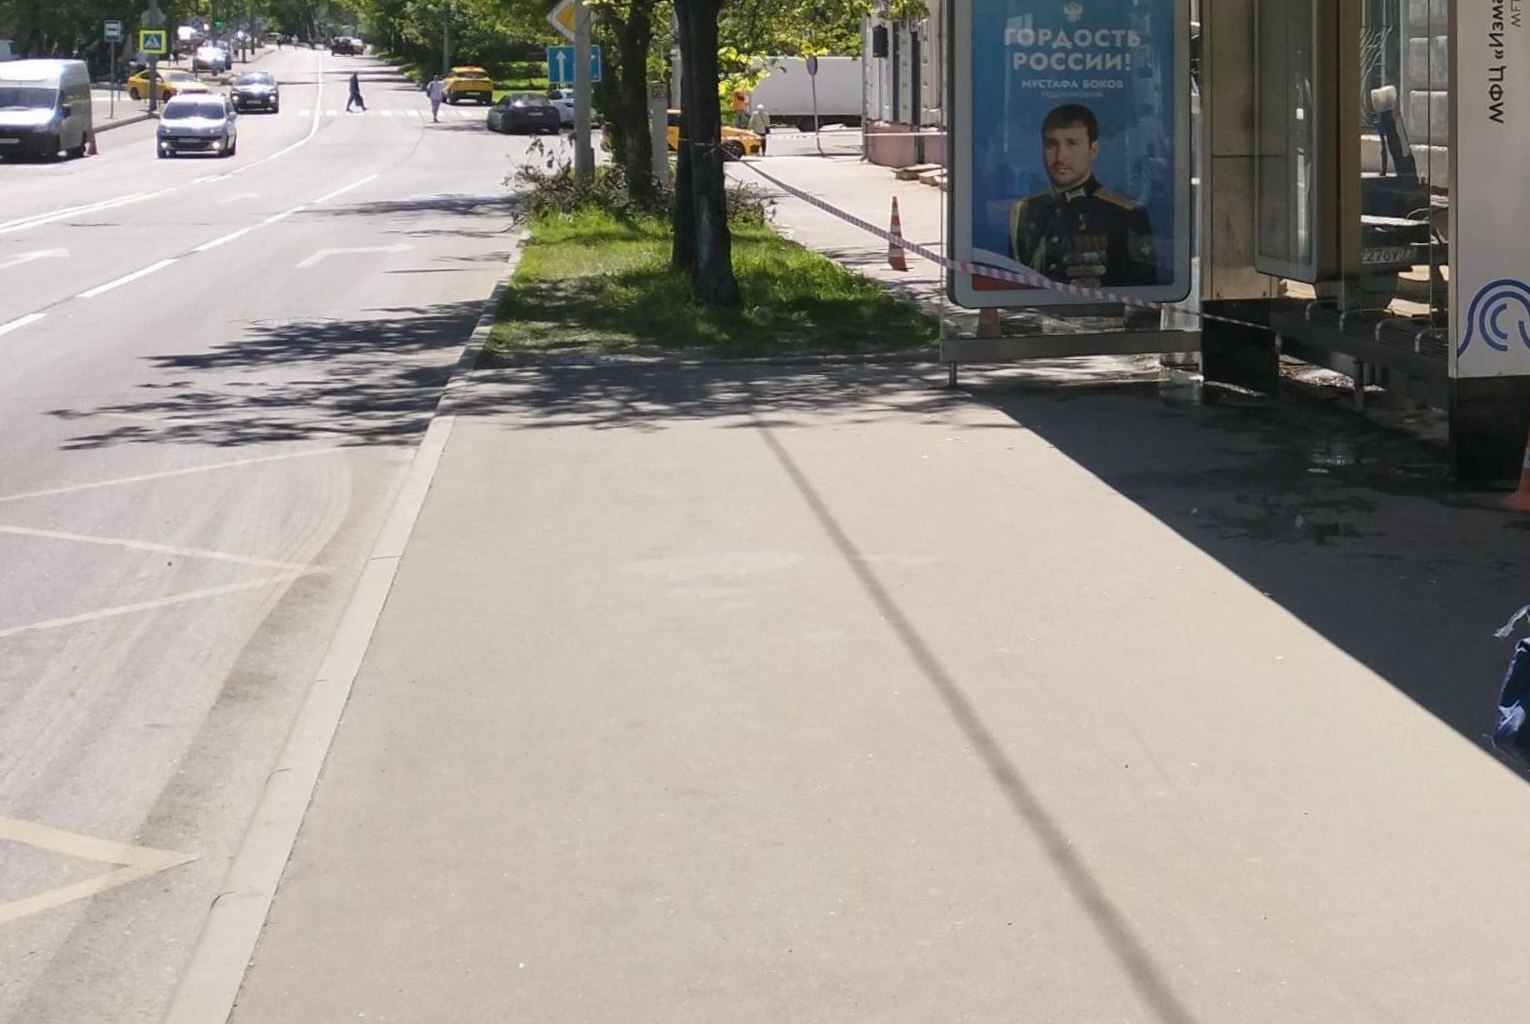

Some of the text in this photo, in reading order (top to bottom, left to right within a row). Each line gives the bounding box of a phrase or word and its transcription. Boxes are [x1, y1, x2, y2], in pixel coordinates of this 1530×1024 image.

[1004, 28, 1141, 49] ГОРДОСТЬ
[1013, 52, 1132, 71] РОССИИ!
[1021, 79, 1124, 89] МУСТАФА БОКОВ
[1488, 65, 1507, 124] МФЦ
